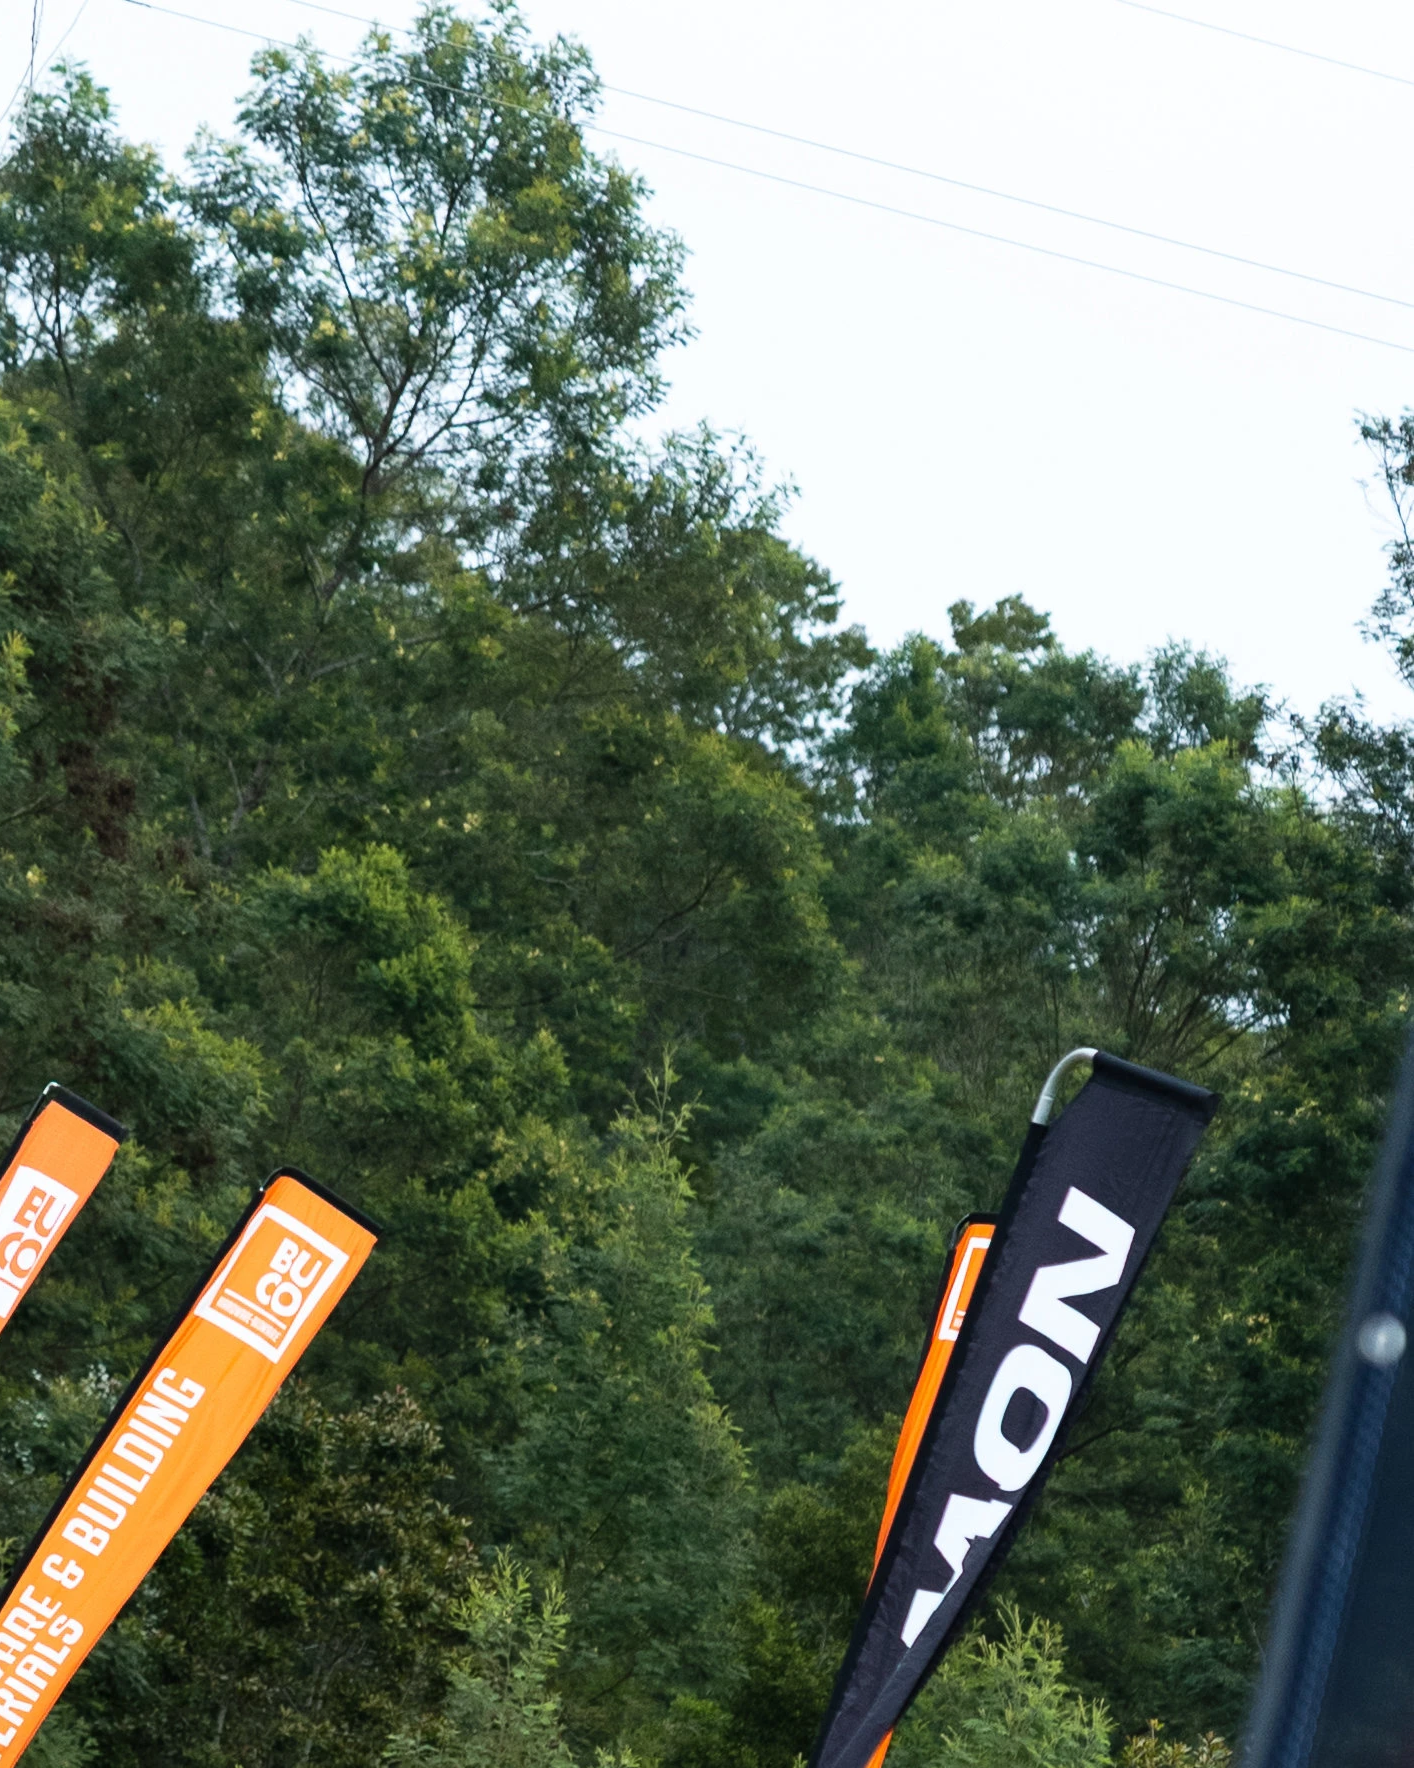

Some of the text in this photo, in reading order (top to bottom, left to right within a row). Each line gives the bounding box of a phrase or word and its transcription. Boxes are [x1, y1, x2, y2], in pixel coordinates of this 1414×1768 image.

[269, 1237, 323, 1289] BU
[255, 1271, 303, 1318] CO
[61, 1366, 207, 1557] BUILDING
[41, 1553, 85, 1590] &
